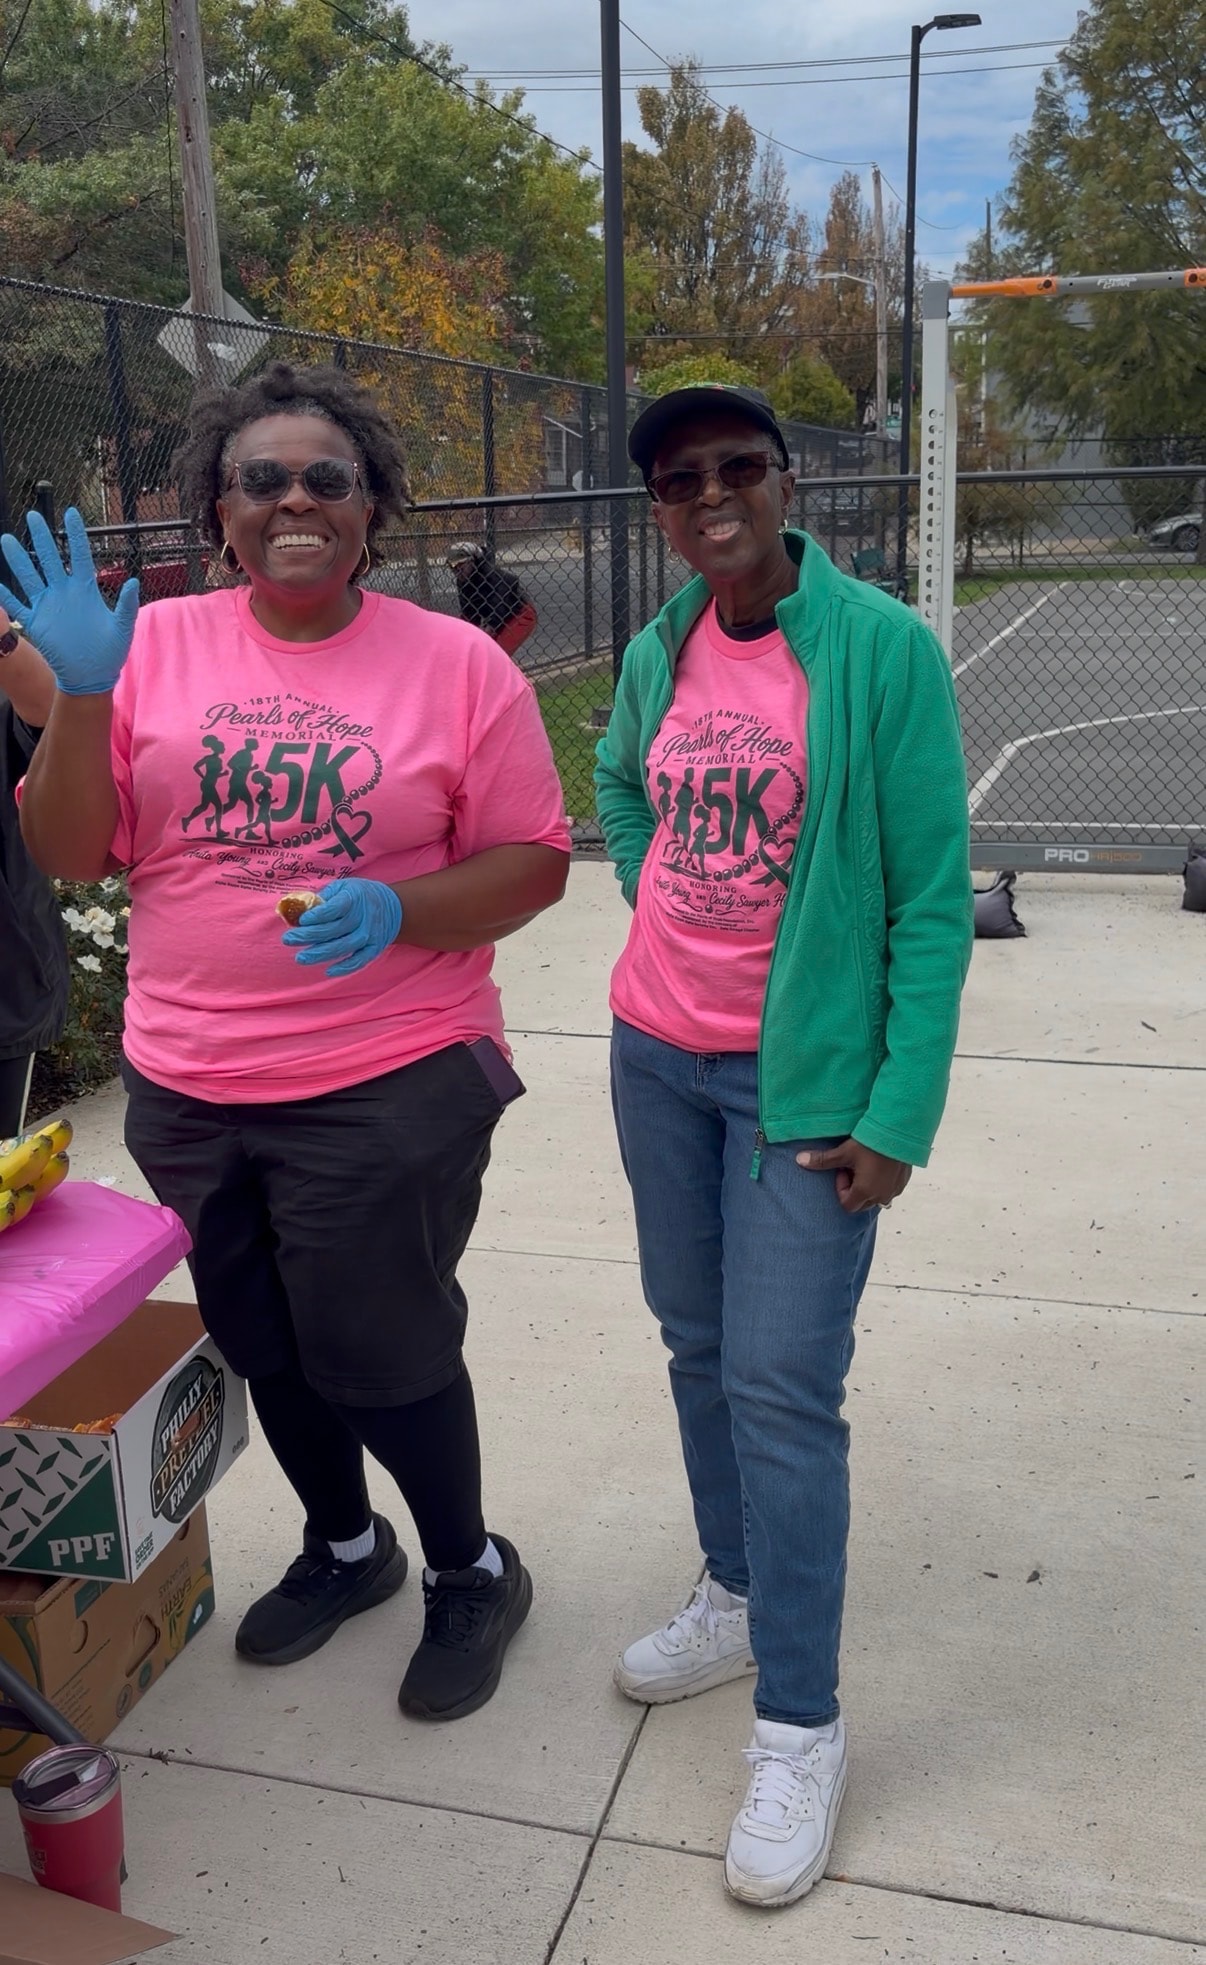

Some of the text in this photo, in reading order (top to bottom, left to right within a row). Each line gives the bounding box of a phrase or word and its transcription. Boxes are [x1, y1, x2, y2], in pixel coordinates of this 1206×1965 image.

[249, 693, 333, 713] 18TH ANNUAL
[199, 703, 373, 740] Pearls of Hope
[694, 709, 759, 729] 18TH ANNUAL
[245, 728, 337, 741] MEMORIAL
[656, 721, 794, 768] Pearls of Hope
[685, 752, 756, 766] MEMORIAL
[264, 742, 361, 824] 5K
[702, 767, 780, 856] 5K
[216, 851, 251, 866] Young
[271, 858, 301, 873] Cecily
[301, 861, 336, 879] Sawyer
[250, 847, 304, 860] HONORING
[1044, 848, 1090, 862] PRO
[689, 880, 737, 894] HONORING
[709, 892, 736, 910] Cecily
[736, 894, 770, 912] Sawyer
[160, 1372, 202, 1454] PHILLY
[170, 1416, 219, 1517] FACTORY
[48, 1532, 116, 1567] PPF
